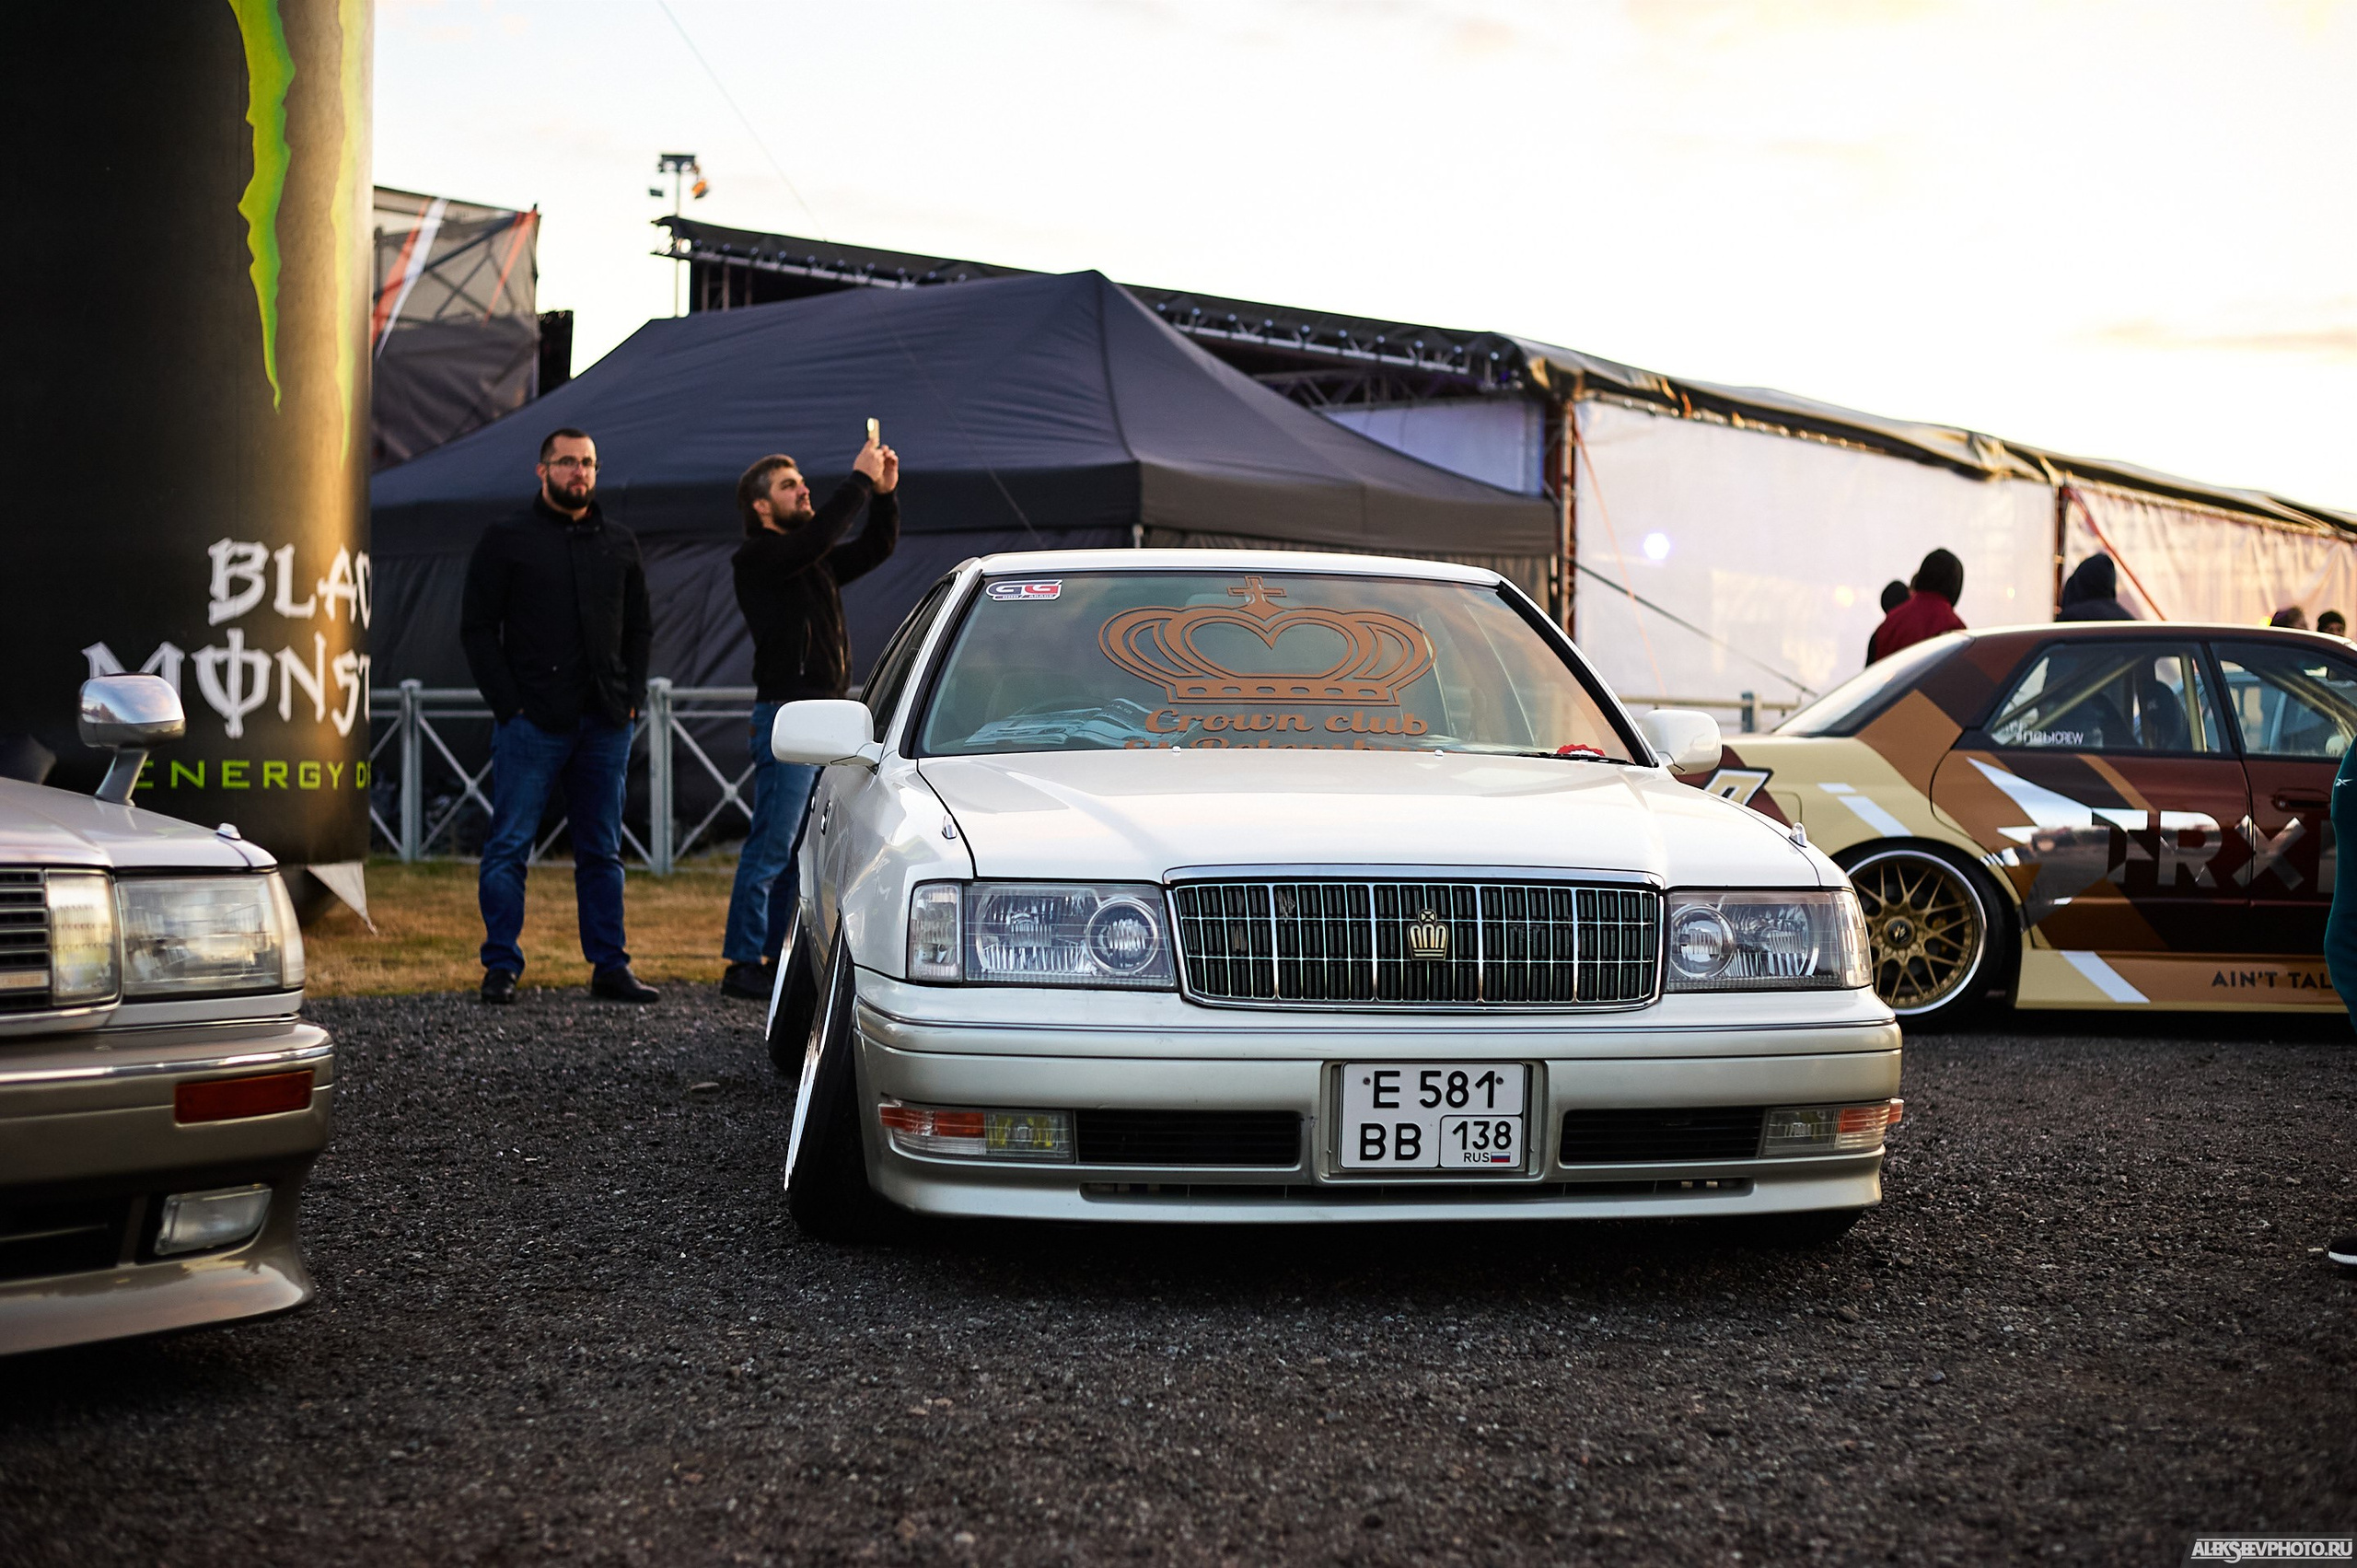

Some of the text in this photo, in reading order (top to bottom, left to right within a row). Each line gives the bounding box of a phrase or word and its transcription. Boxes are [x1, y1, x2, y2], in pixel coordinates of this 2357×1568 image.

[1145, 708, 1314, 734] Crown
[1325, 710, 1427, 736] club
[2212, 970, 2278, 988] AIN'T
[1373, 1070, 1495, 1109] E 581
[1359, 1121, 1512, 1161] BB 138
[1463, 1153, 1490, 1162] RUS
